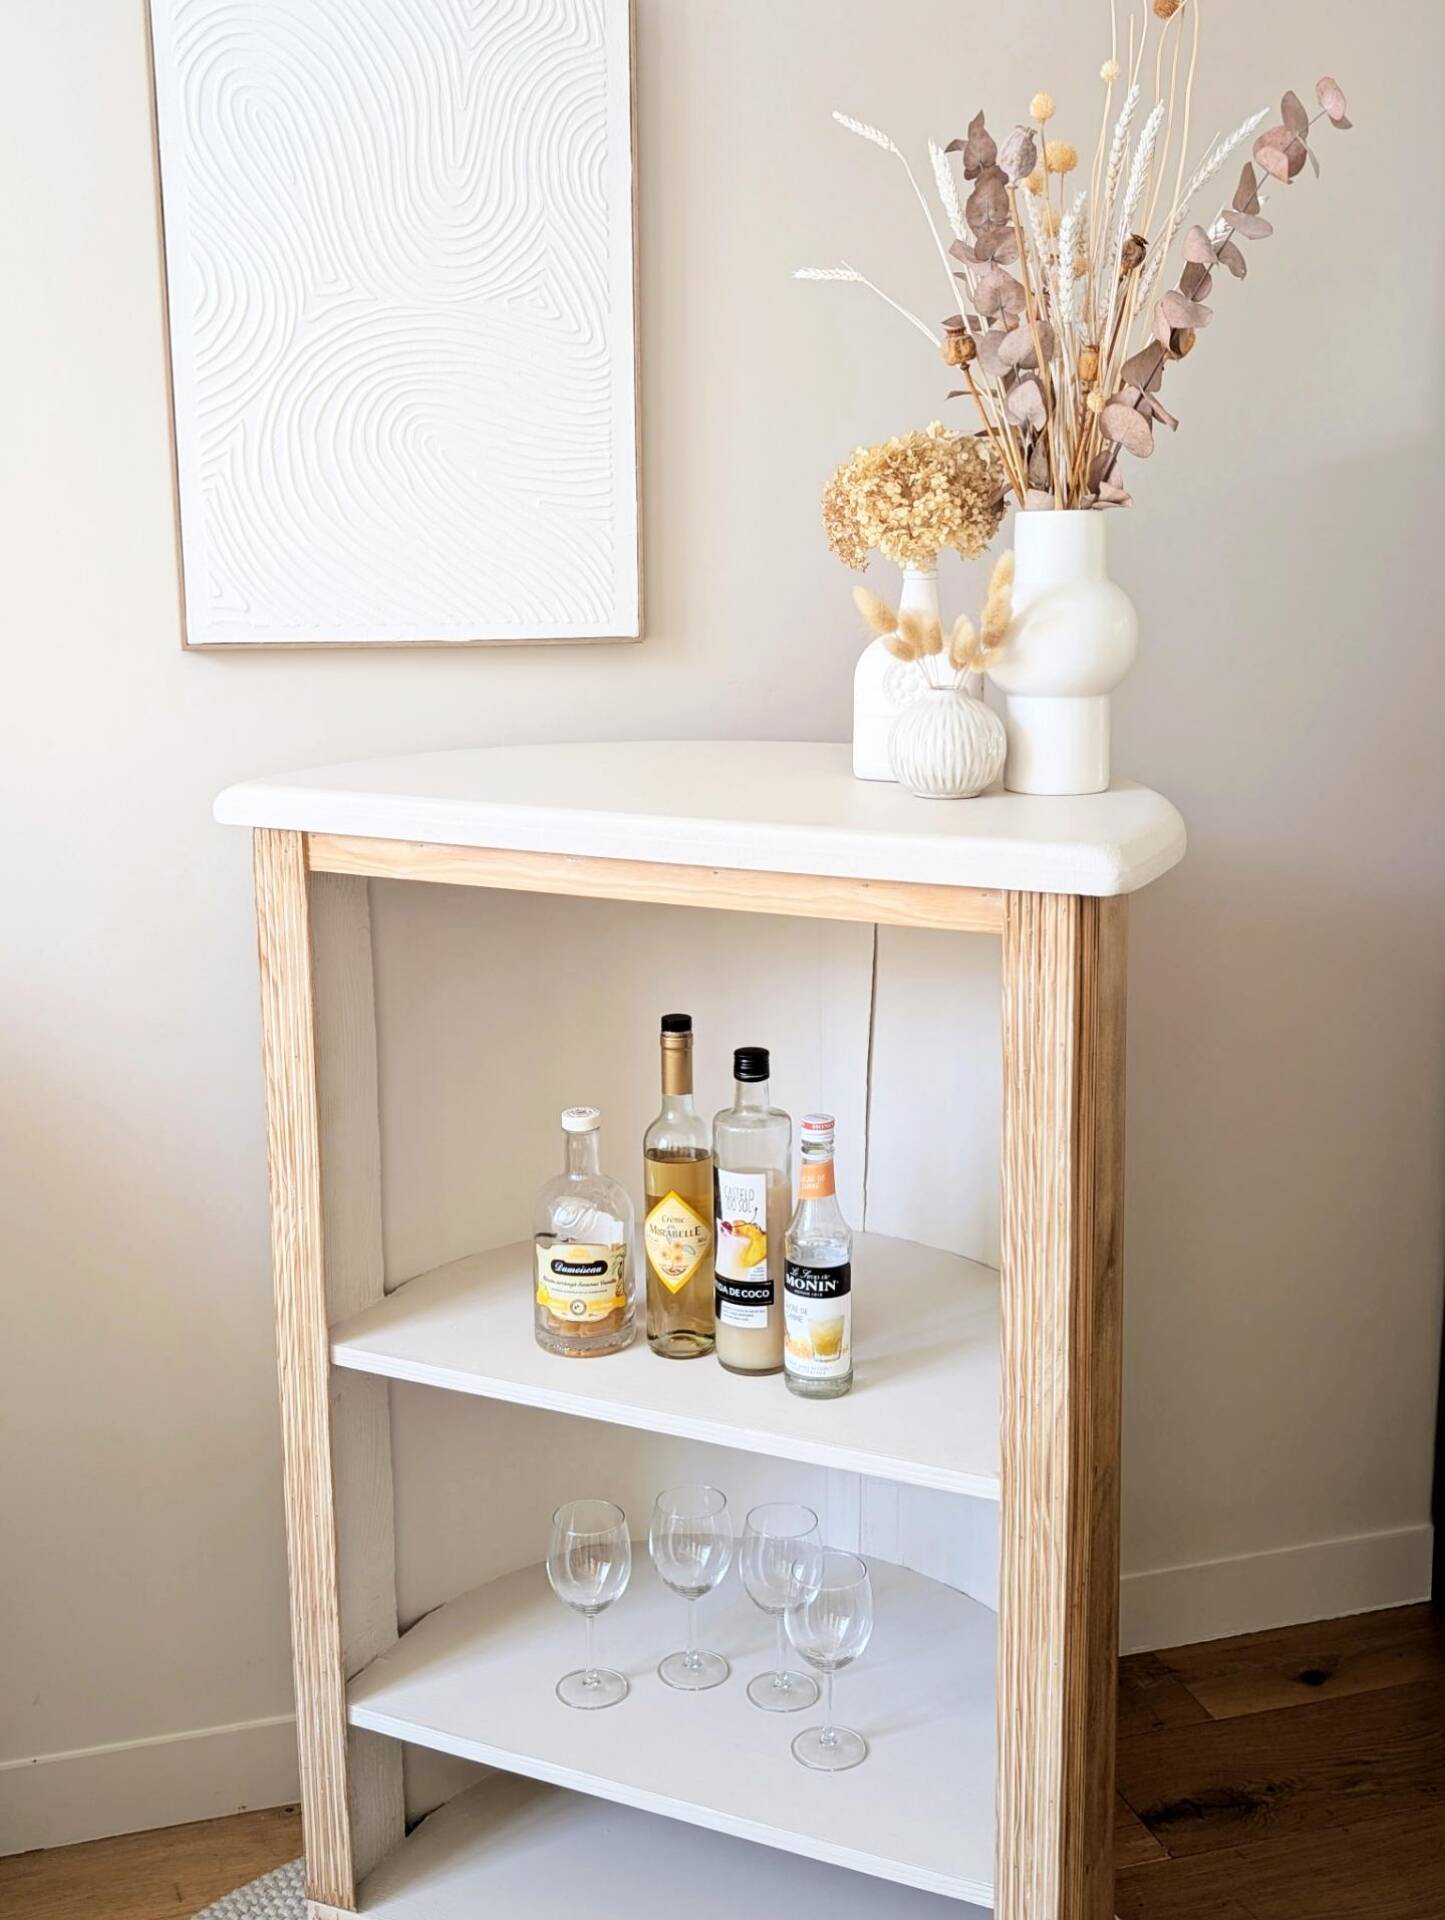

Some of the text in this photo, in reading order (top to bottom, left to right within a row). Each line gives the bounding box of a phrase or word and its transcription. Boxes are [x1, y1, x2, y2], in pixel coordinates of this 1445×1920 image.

[553, 1261, 603, 1274] Damoiseau
[785, 1273, 837, 1293] MONIN
[729, 1287, 741, 1298] DE
[741, 1289, 770, 1299] COCO
